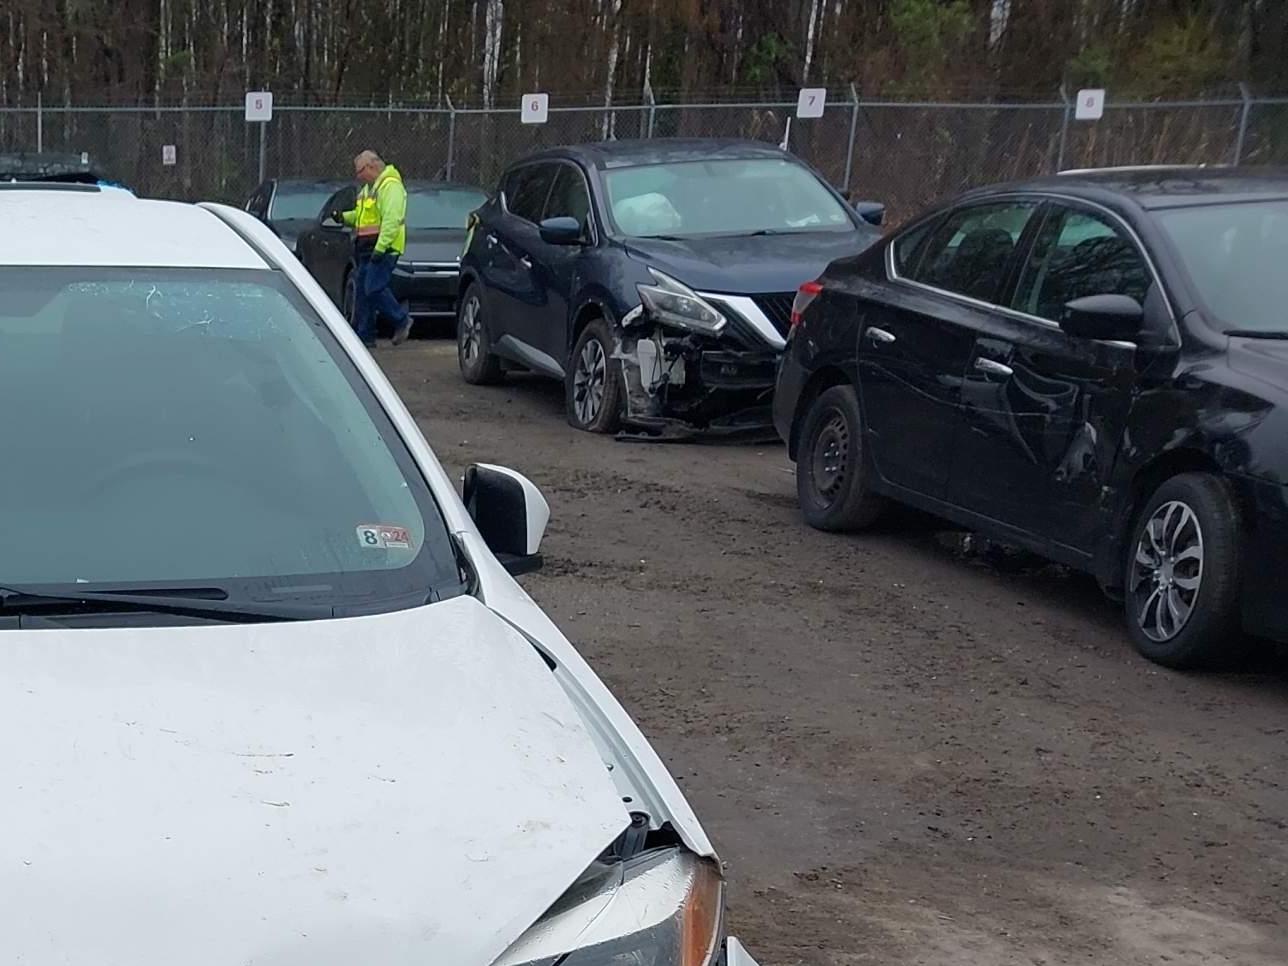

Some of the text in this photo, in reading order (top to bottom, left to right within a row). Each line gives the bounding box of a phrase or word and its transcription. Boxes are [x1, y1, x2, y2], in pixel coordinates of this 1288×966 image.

[254, 99, 263, 110] 5
[530, 101, 539, 111] 6
[807, 96, 816, 106] 7
[364, 530, 377, 545] 8
